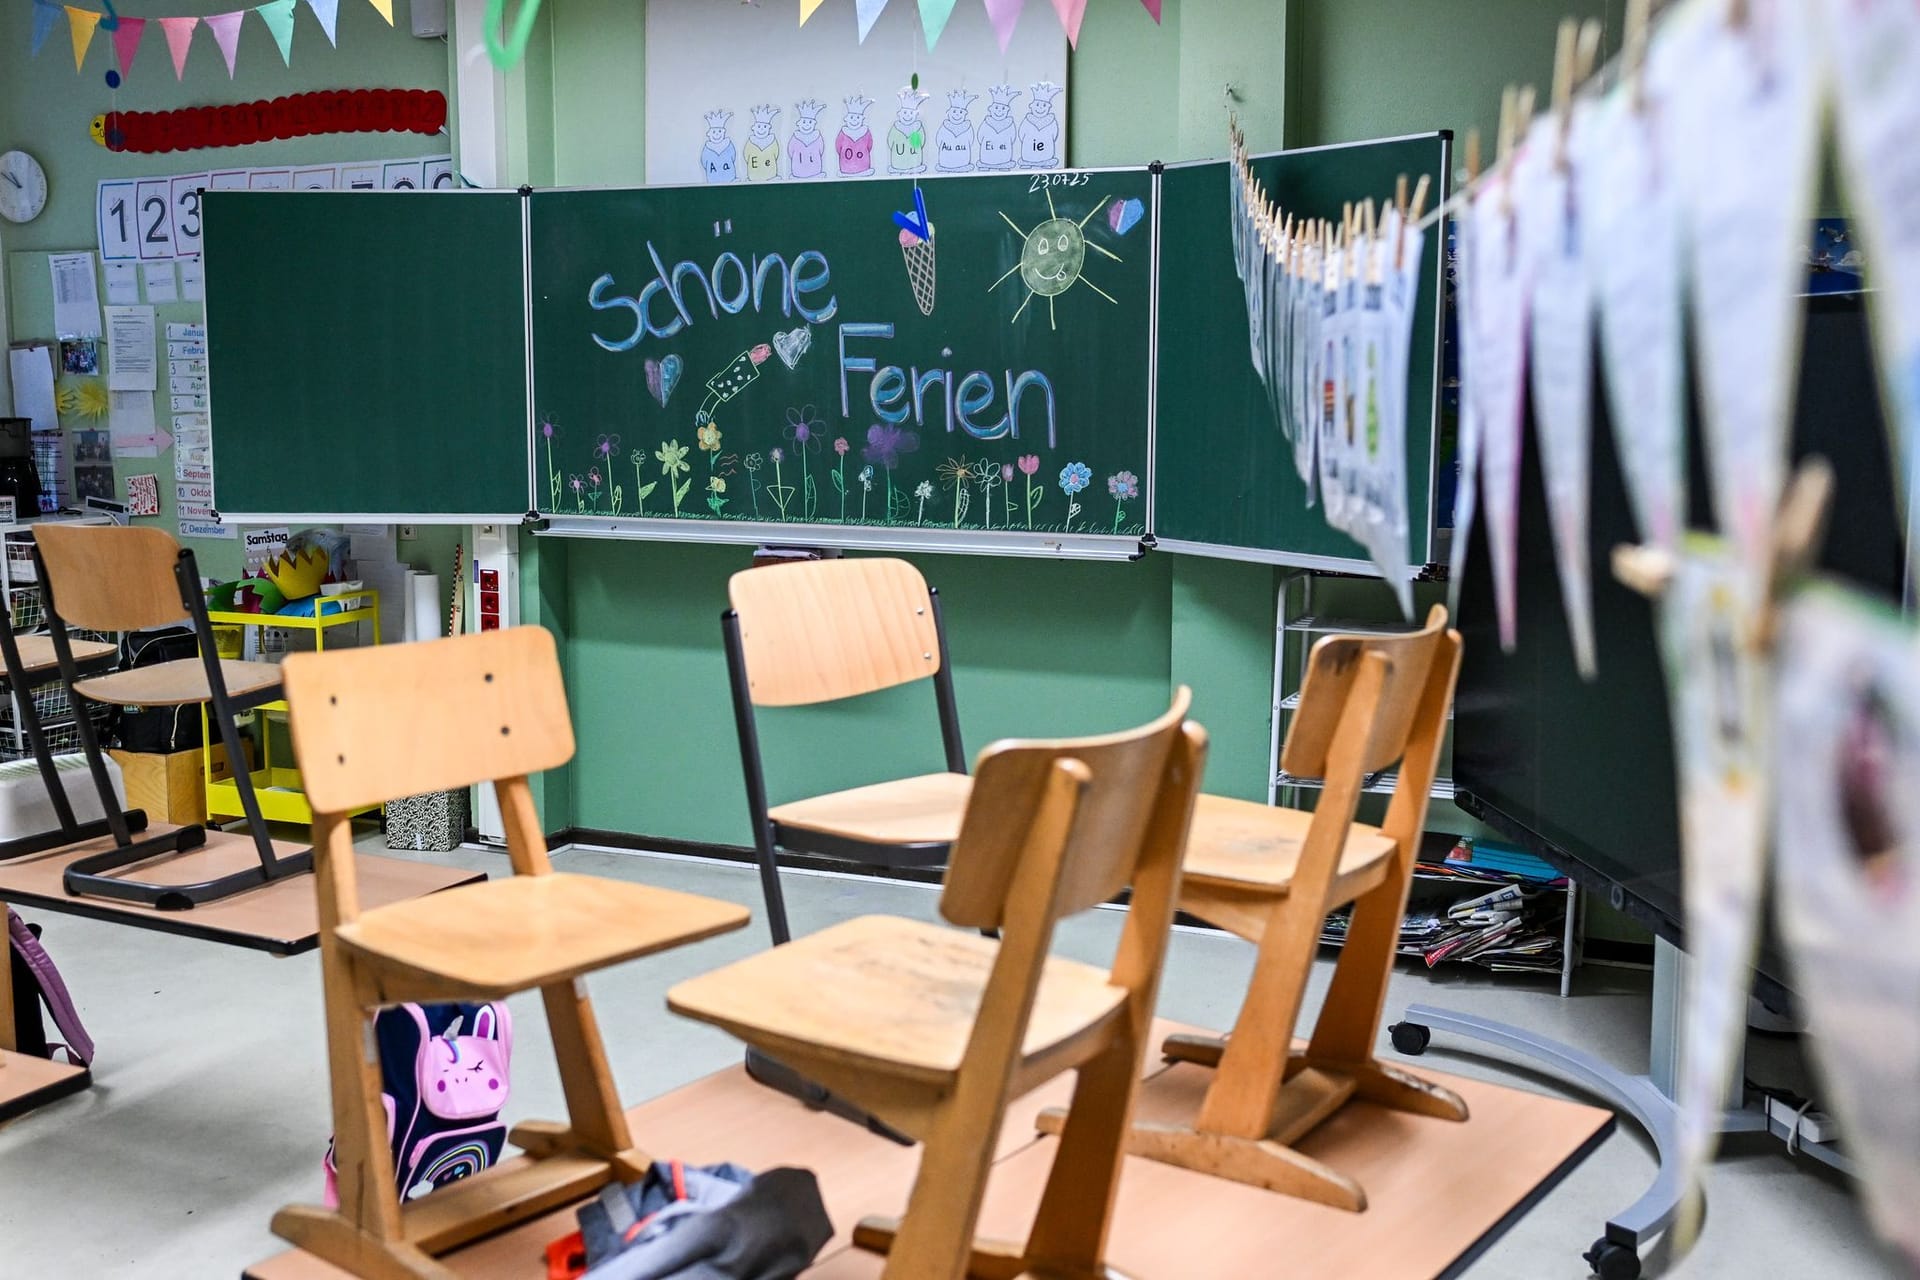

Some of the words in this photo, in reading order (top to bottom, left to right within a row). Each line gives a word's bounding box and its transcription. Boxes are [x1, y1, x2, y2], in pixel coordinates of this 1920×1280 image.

[896, 143, 905, 155] U
[909, 146, 918, 155] u
[941, 143, 952, 151] Au
[1033, 139, 1045, 151] ie
[845, 148, 853, 160] O
[710, 163, 717, 173] A
[723, 162, 730, 171] a
[751, 156, 758, 168] E
[111, 199, 126, 242] 1
[144, 197, 169, 243] 2
[180, 191, 200, 237] 3
[588, 218, 837, 352] Schöne
[838, 322, 1057, 449] Ferien
[189, 524, 226, 535] Dezember
[246, 533, 288, 546] Samstag
